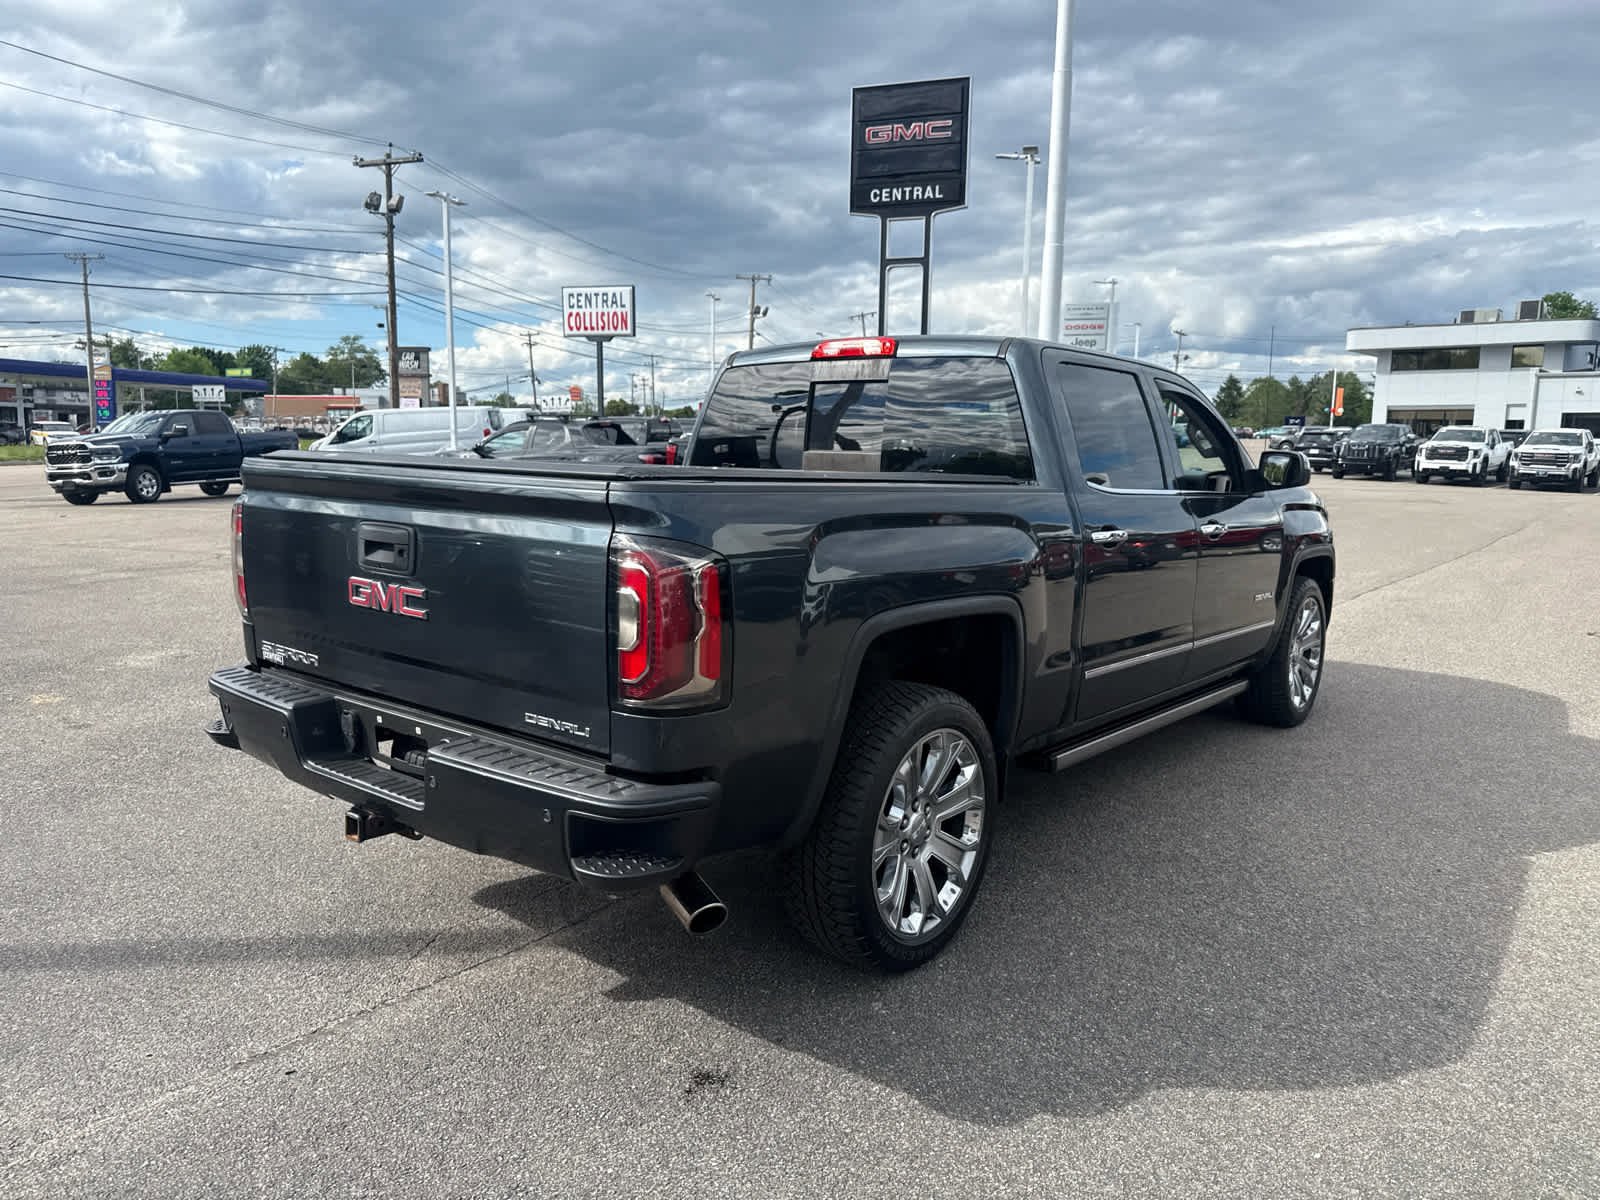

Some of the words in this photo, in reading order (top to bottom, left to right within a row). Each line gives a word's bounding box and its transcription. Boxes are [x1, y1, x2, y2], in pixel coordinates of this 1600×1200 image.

[865, 119, 953, 144] GMC
[870, 185, 944, 203] CENTRAL
[568, 291, 626, 309] CENTRAL
[567, 311, 629, 332] COLLISION
[1070, 337, 1097, 348] Jeep
[399, 360, 419, 369] WASH
[401, 351, 416, 361] CAR
[348, 576, 430, 620] GMC
[524, 712, 590, 738] DENALI
